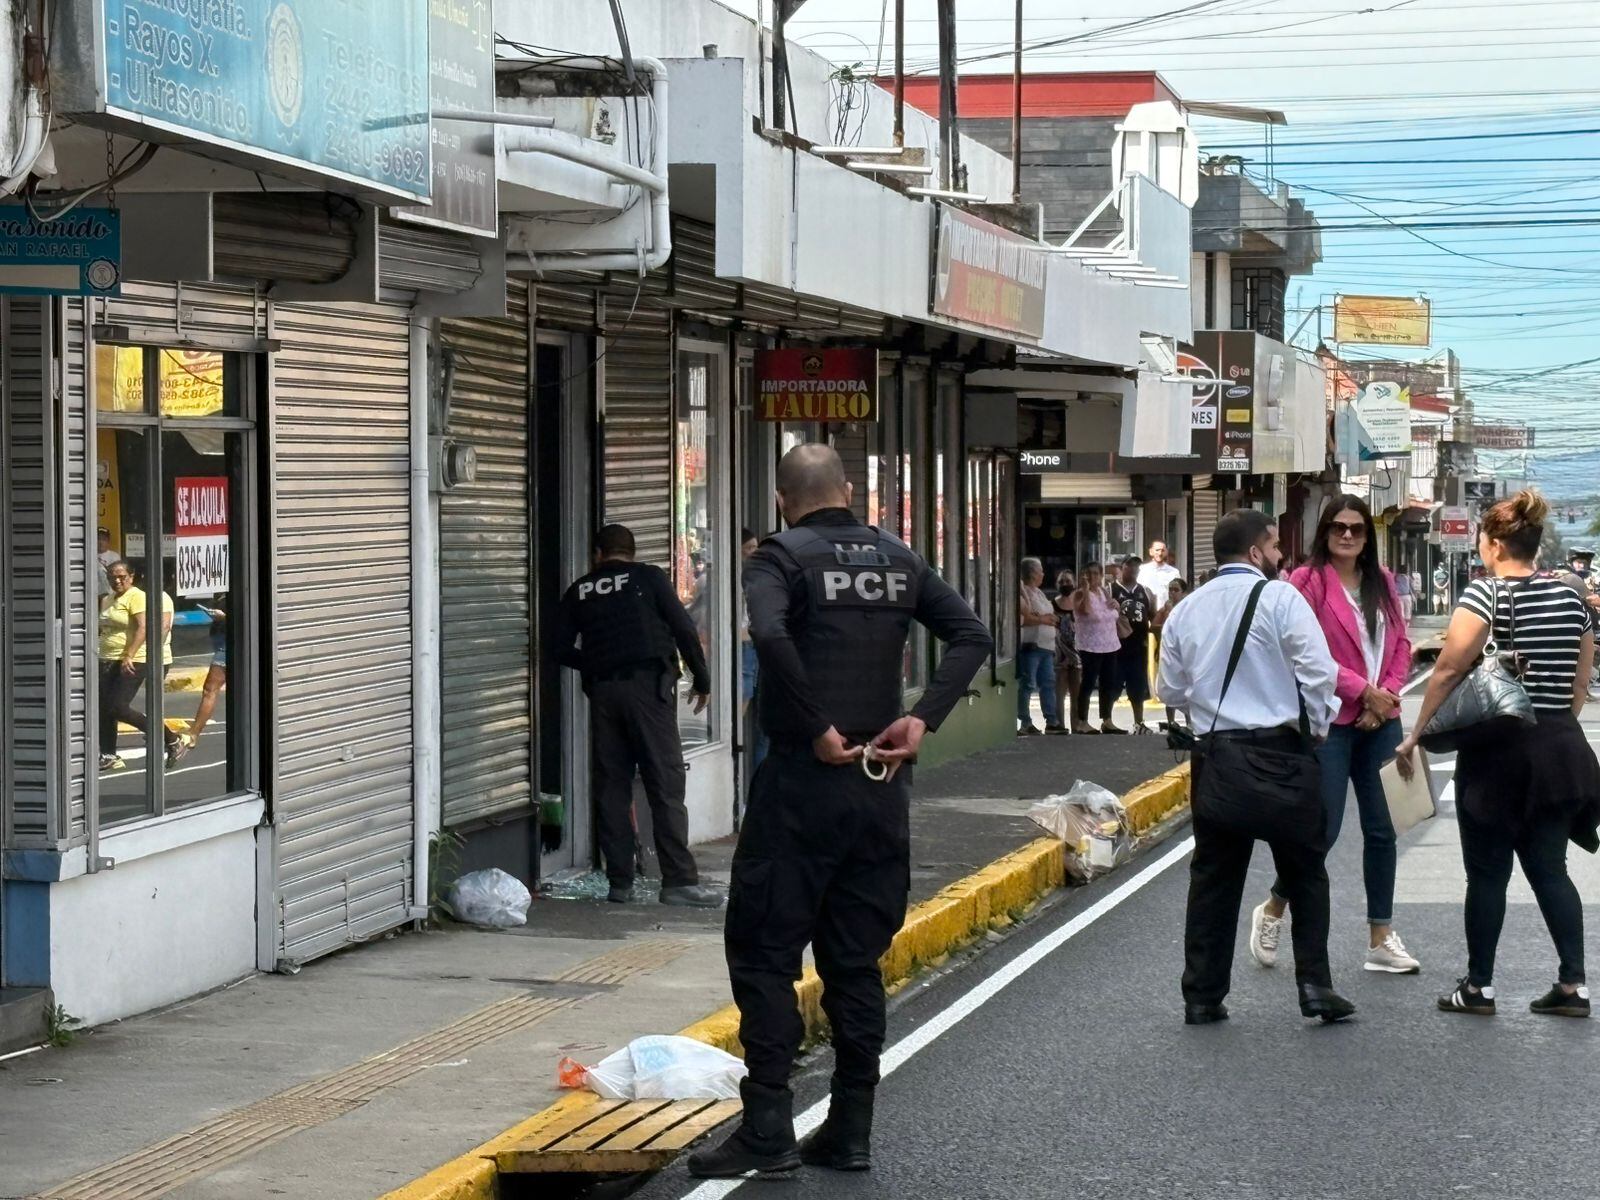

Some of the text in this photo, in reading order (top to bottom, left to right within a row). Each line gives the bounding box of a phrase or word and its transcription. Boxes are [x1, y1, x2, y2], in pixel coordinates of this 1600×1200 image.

[124, 5, 219, 77] Rayos X.
[26, 241, 90, 257] RAFAEL
[761, 380, 868, 392] IMPORTADORA
[761, 393, 870, 418] TAURO
[178, 486, 226, 527] SE ALQUILA
[178, 544, 228, 589] 8395-0447
[578, 573, 630, 600] PCF
[823, 571, 908, 602] PCF
